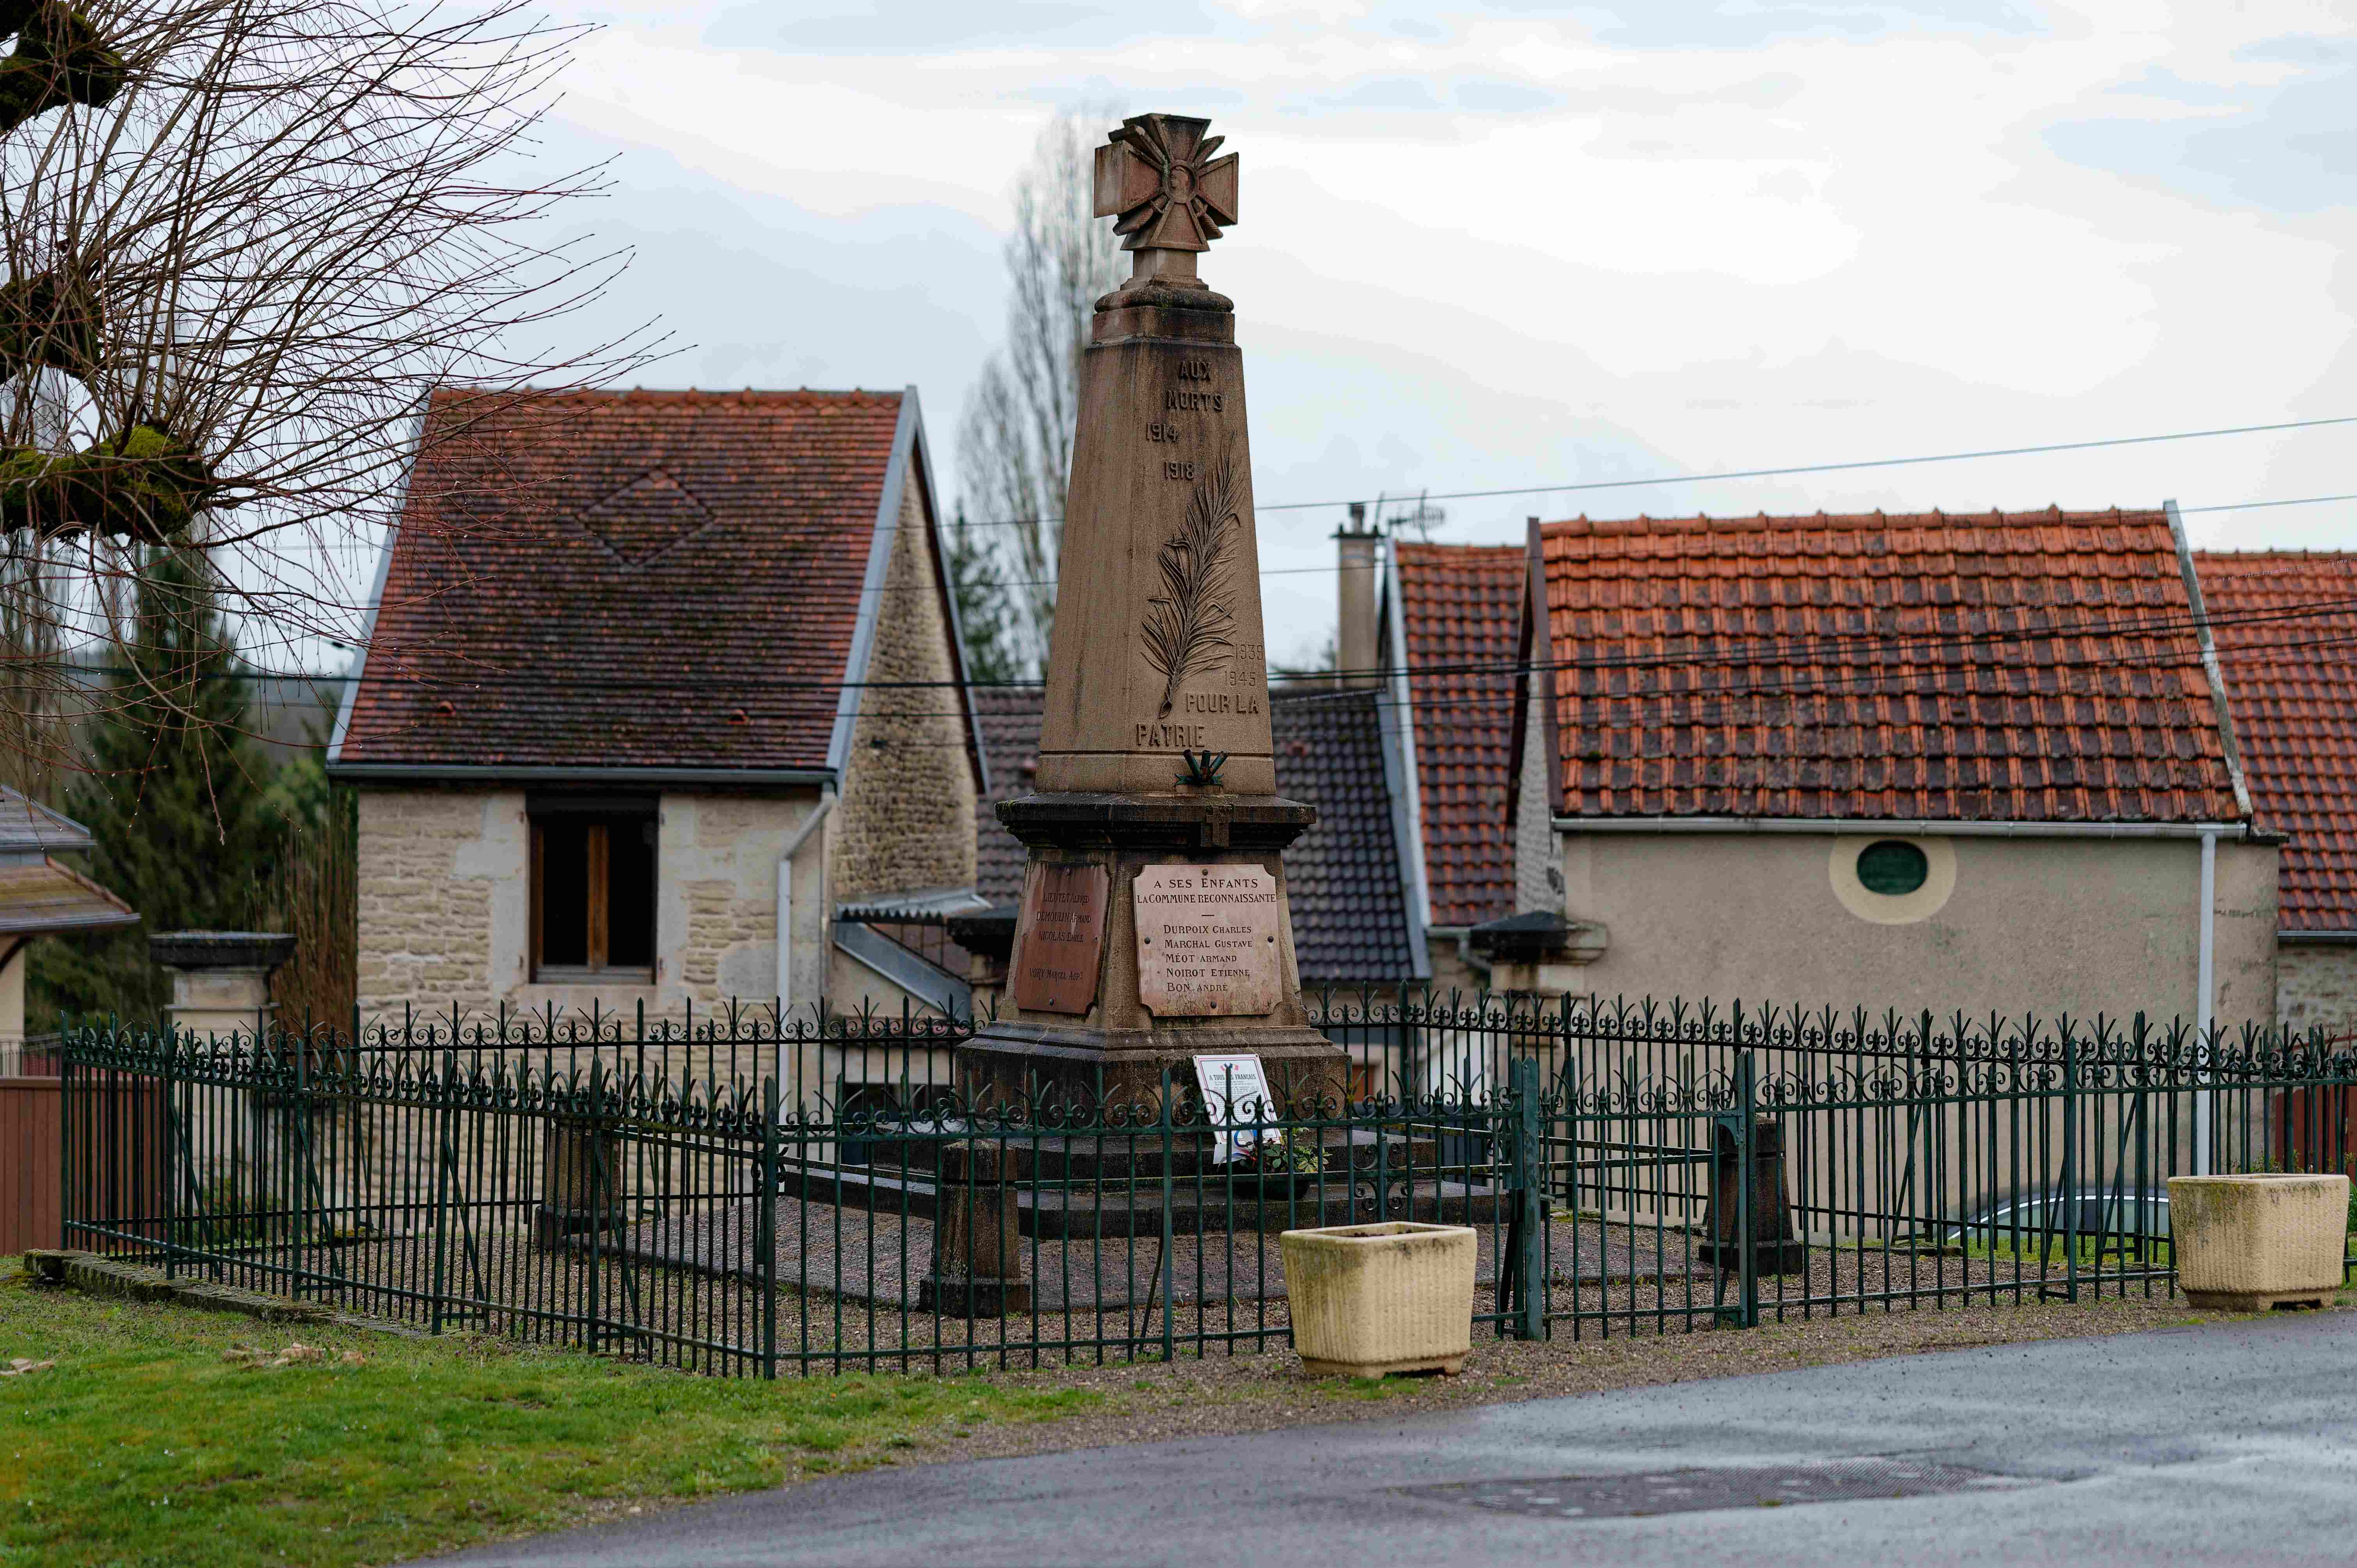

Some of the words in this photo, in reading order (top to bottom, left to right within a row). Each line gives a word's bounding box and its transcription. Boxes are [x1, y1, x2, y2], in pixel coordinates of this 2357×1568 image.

[1179, 361, 1210, 381] AUX
[1166, 390, 1223, 412] MORTS
[1146, 422, 1179, 443] 1914
[1164, 461, 1194, 480] 1918
[1234, 644, 1264, 660] 1939
[1224, 670, 1255, 686] 1945
[1186, 692, 1230, 713] POUR
[1236, 693, 1259, 714] LA
[1136, 723, 1206, 747] PATRIE
[1154, 880, 1162, 888] A
[1169, 879, 1192, 888] SES
[1201, 878, 1258, 888] ENFANTS
[1149, 894, 1196, 903] COMMUNE
[1198, 893, 1276, 903] RECONNAISSANTE
[1038, 930, 1065, 942] NICOLAS
[1164, 924, 1209, 934] DURPOIX
[1212, 925, 1251, 934] CHARLES
[1164, 939, 1210, 948] MARCHAL
[1214, 940, 1252, 948] GUSTAVE
[1166, 953, 1195, 963] MÉOT
[1166, 968, 1205, 978] NOIROT
[1211, 969, 1250, 978] ETIENNE
[1167, 982, 1190, 992] BON
[1196, 982, 1228, 992] ANDRÉ
